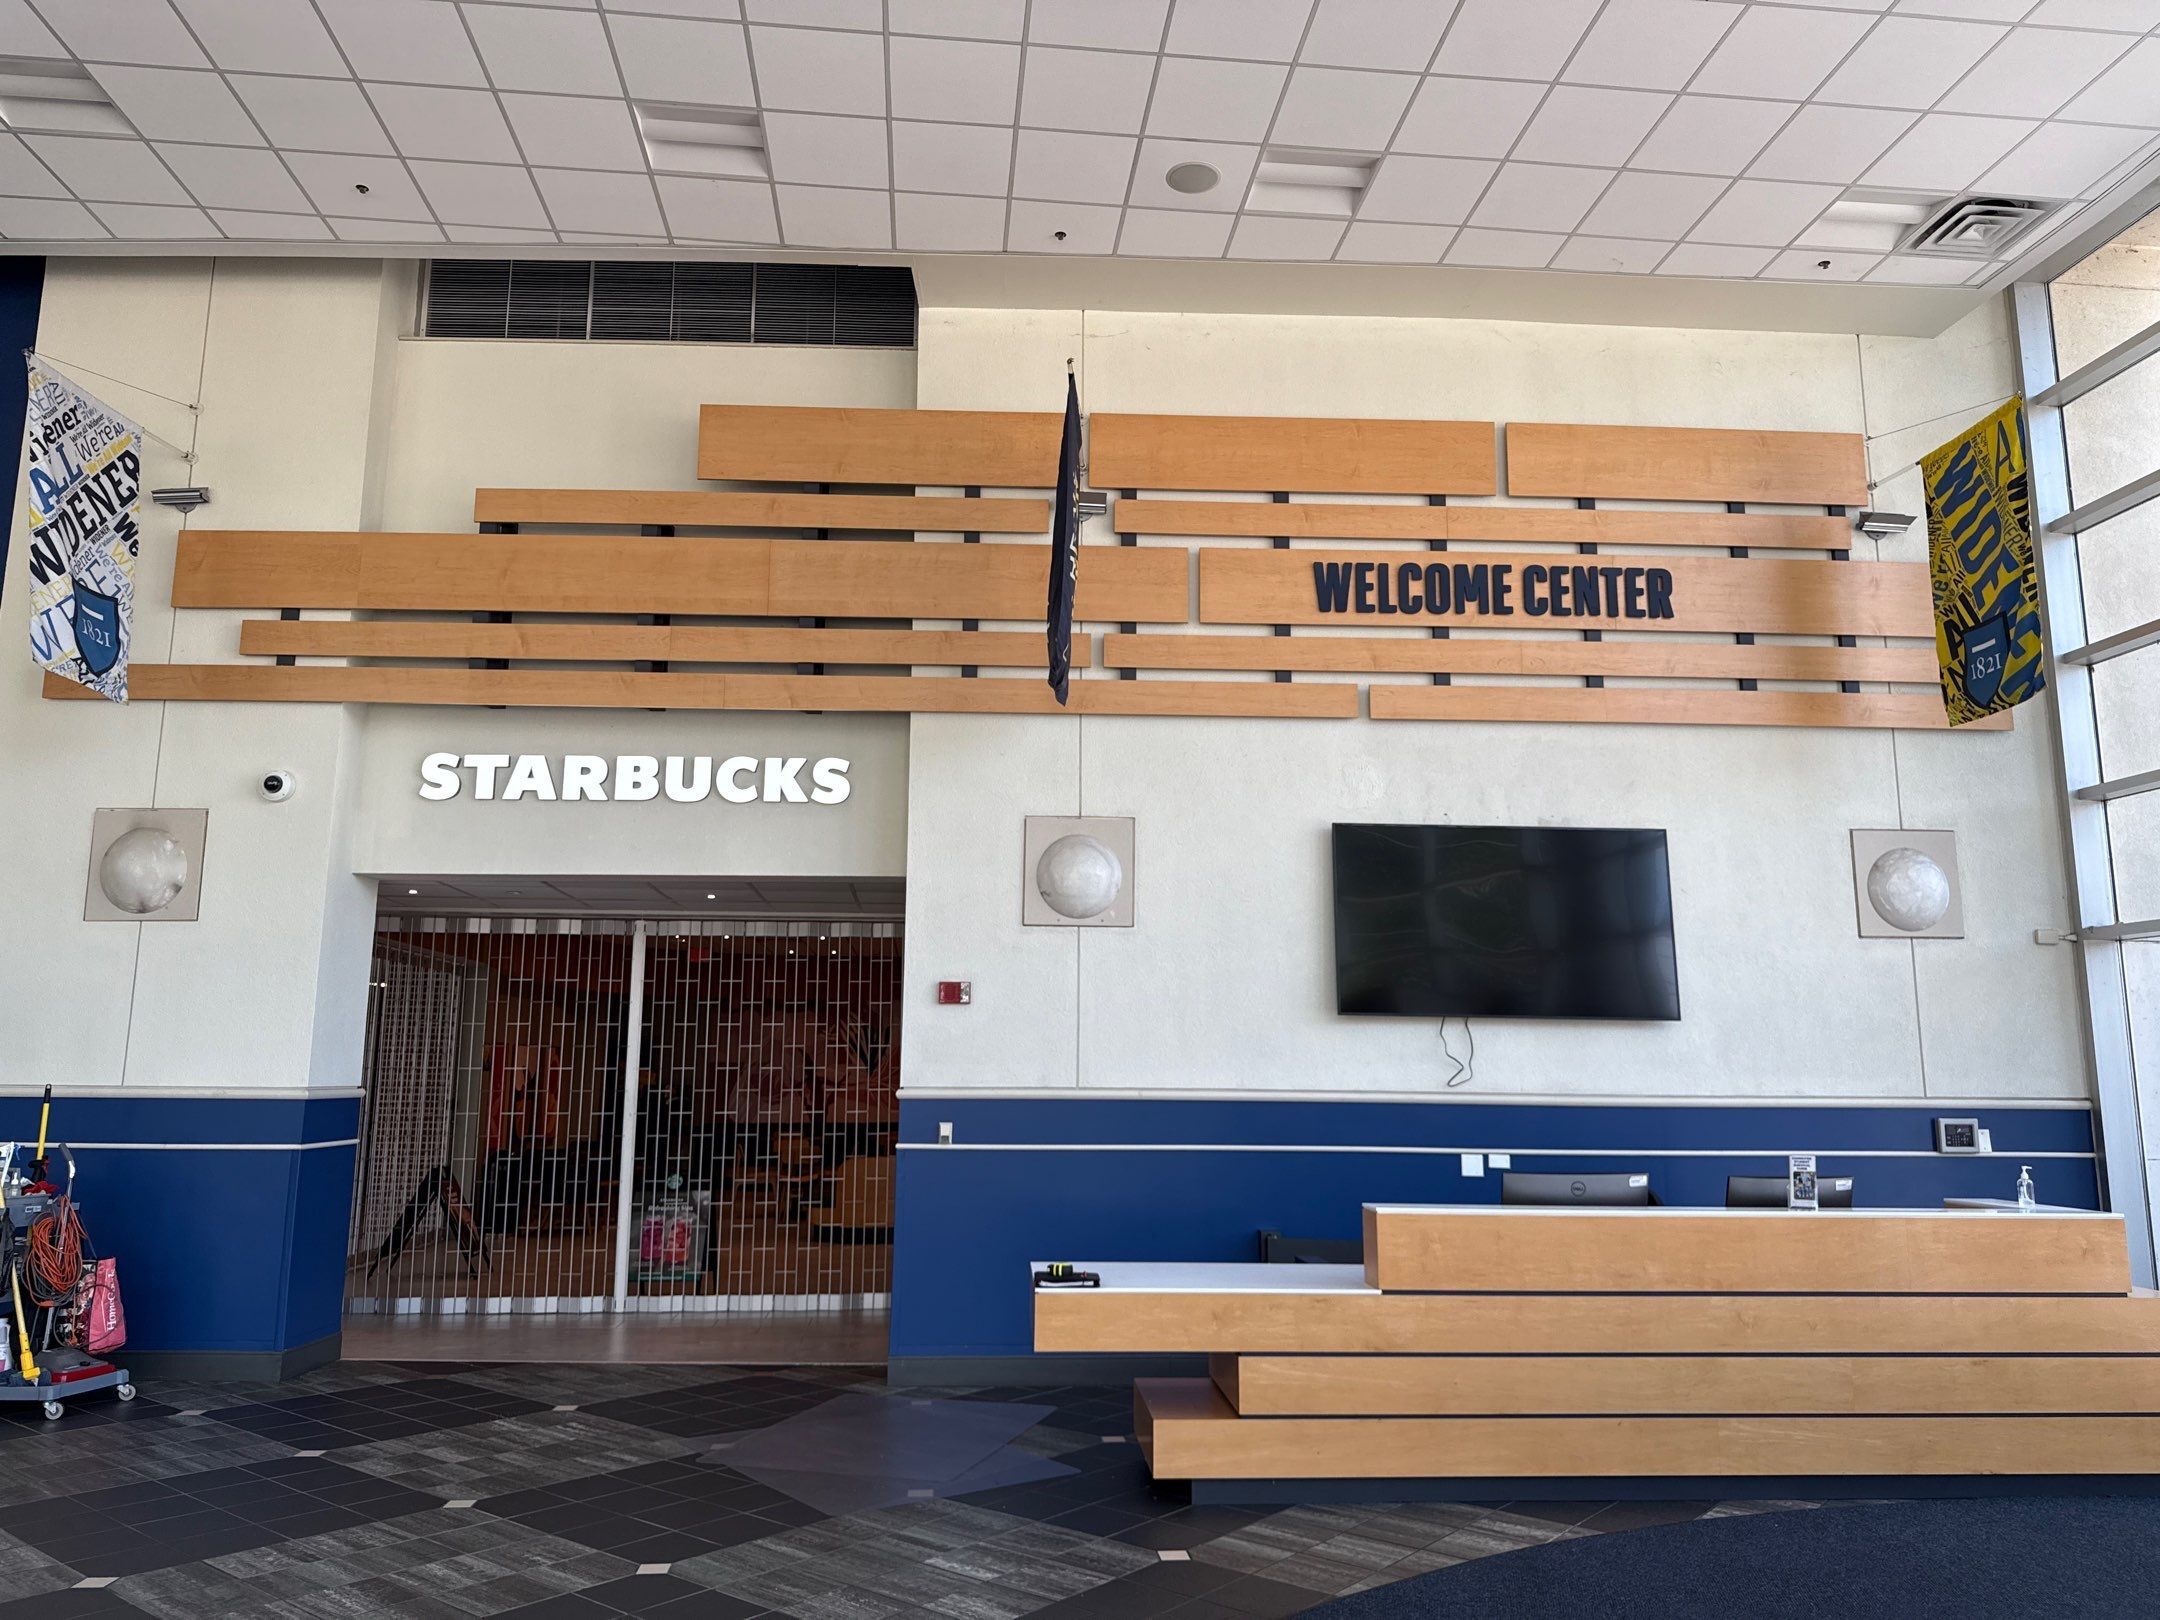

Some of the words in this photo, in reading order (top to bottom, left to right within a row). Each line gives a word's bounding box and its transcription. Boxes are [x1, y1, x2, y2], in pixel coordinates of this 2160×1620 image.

[75, 424, 115, 462] We're
[30, 450, 139, 586] WIDENER
[1313, 561, 1514, 616] WELCOME
[1523, 564, 1674, 619] CENTER
[81, 618, 112, 648] 1821
[1971, 652, 2002, 681] 1821
[418, 752, 851, 805] STARBUCKS
